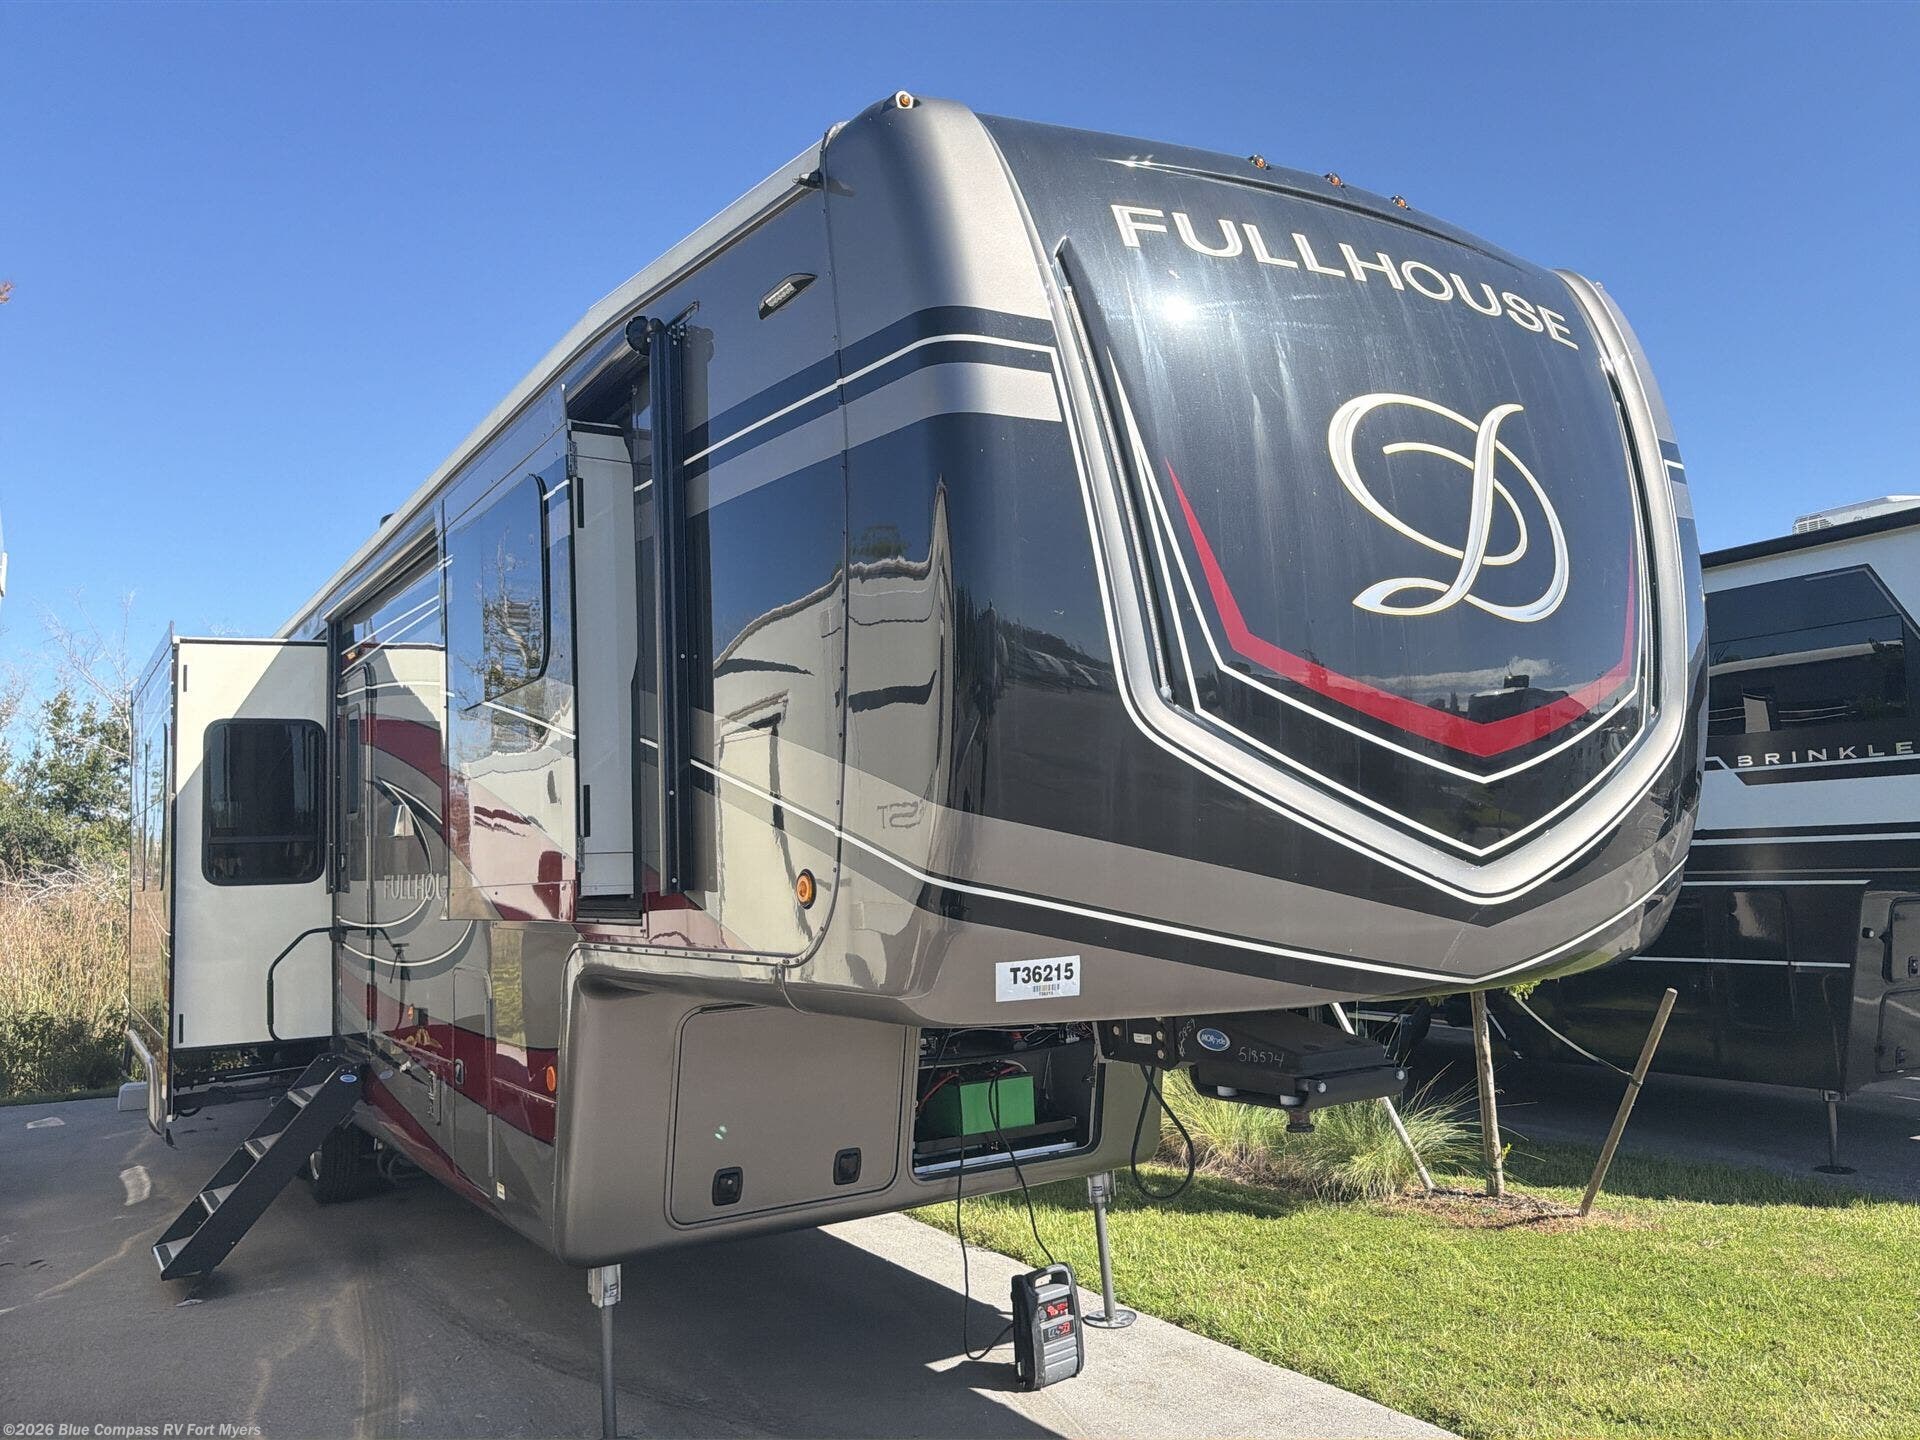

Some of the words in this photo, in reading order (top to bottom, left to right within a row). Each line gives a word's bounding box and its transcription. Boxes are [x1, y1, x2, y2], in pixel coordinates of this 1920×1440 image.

[1111, 204, 1579, 351] FULLHOUSE
[1738, 741, 1914, 767] BRINKLE
[1010, 963, 1074, 984] T36215
